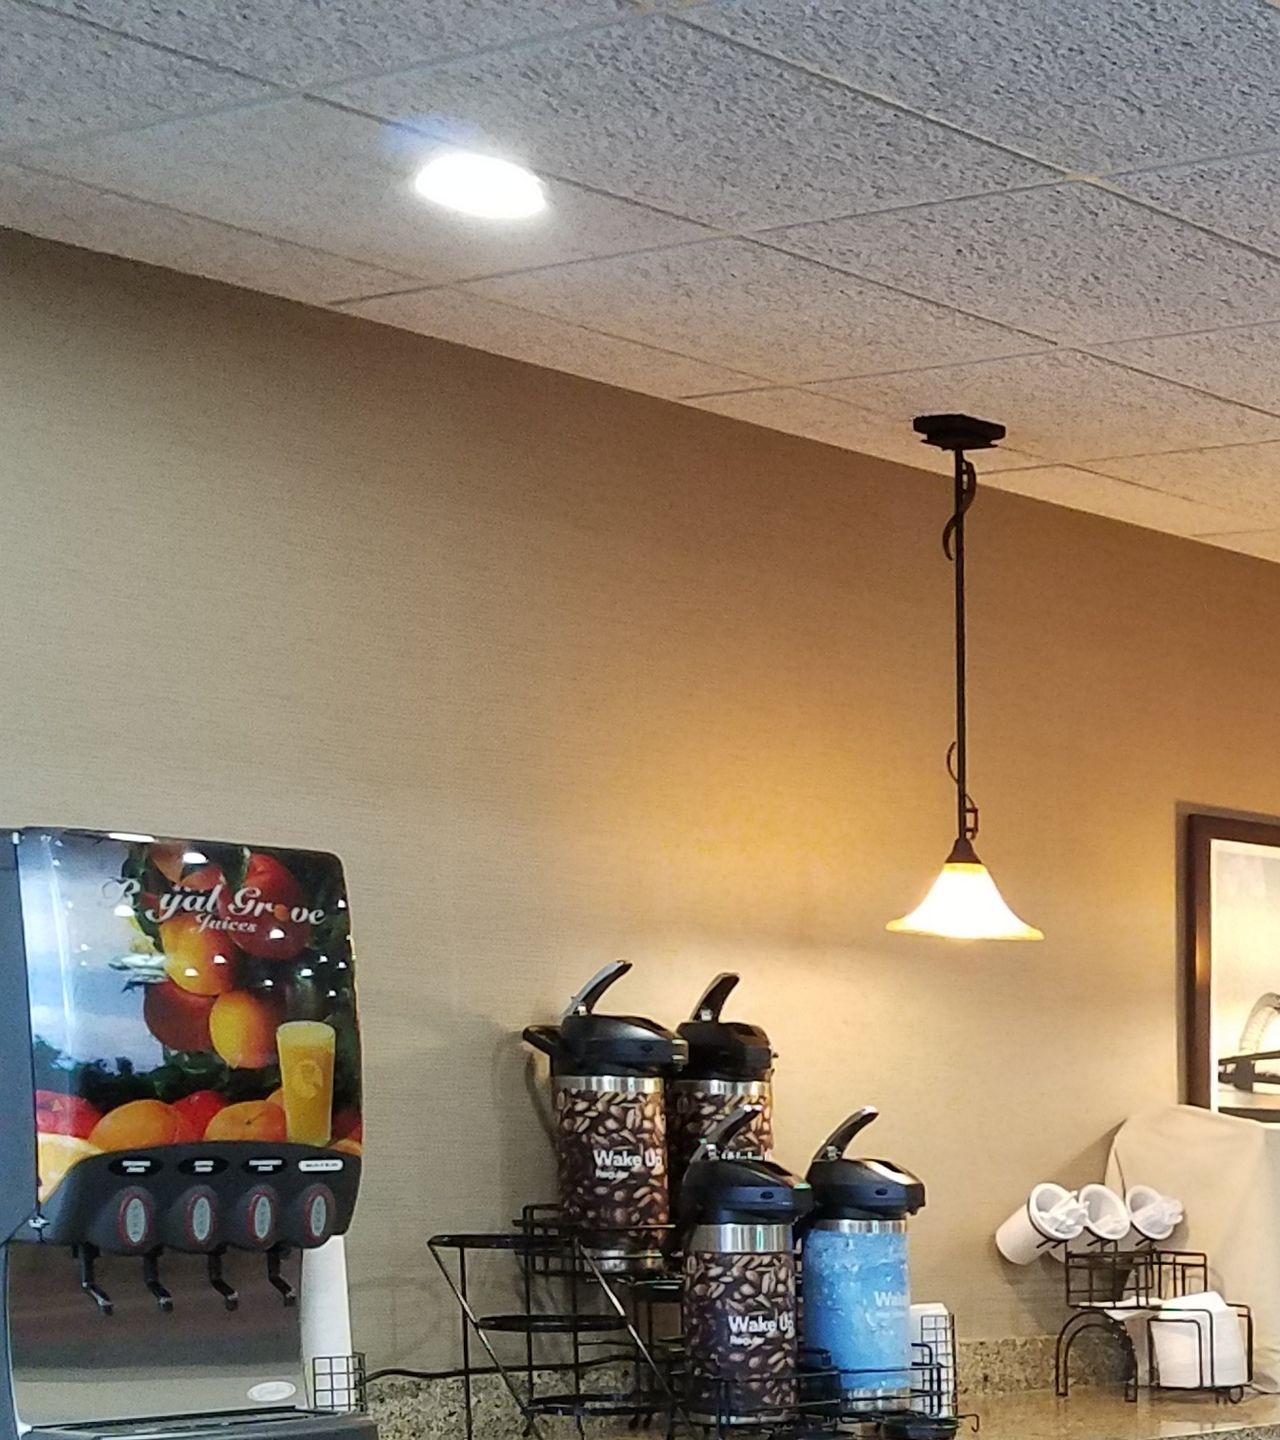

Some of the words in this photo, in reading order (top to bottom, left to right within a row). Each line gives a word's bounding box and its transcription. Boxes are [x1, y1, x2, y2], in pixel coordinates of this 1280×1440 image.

[194, 914, 257, 933] Juices
[593, 1149, 643, 1167] Wake
[728, 1315, 777, 1333] Wake
